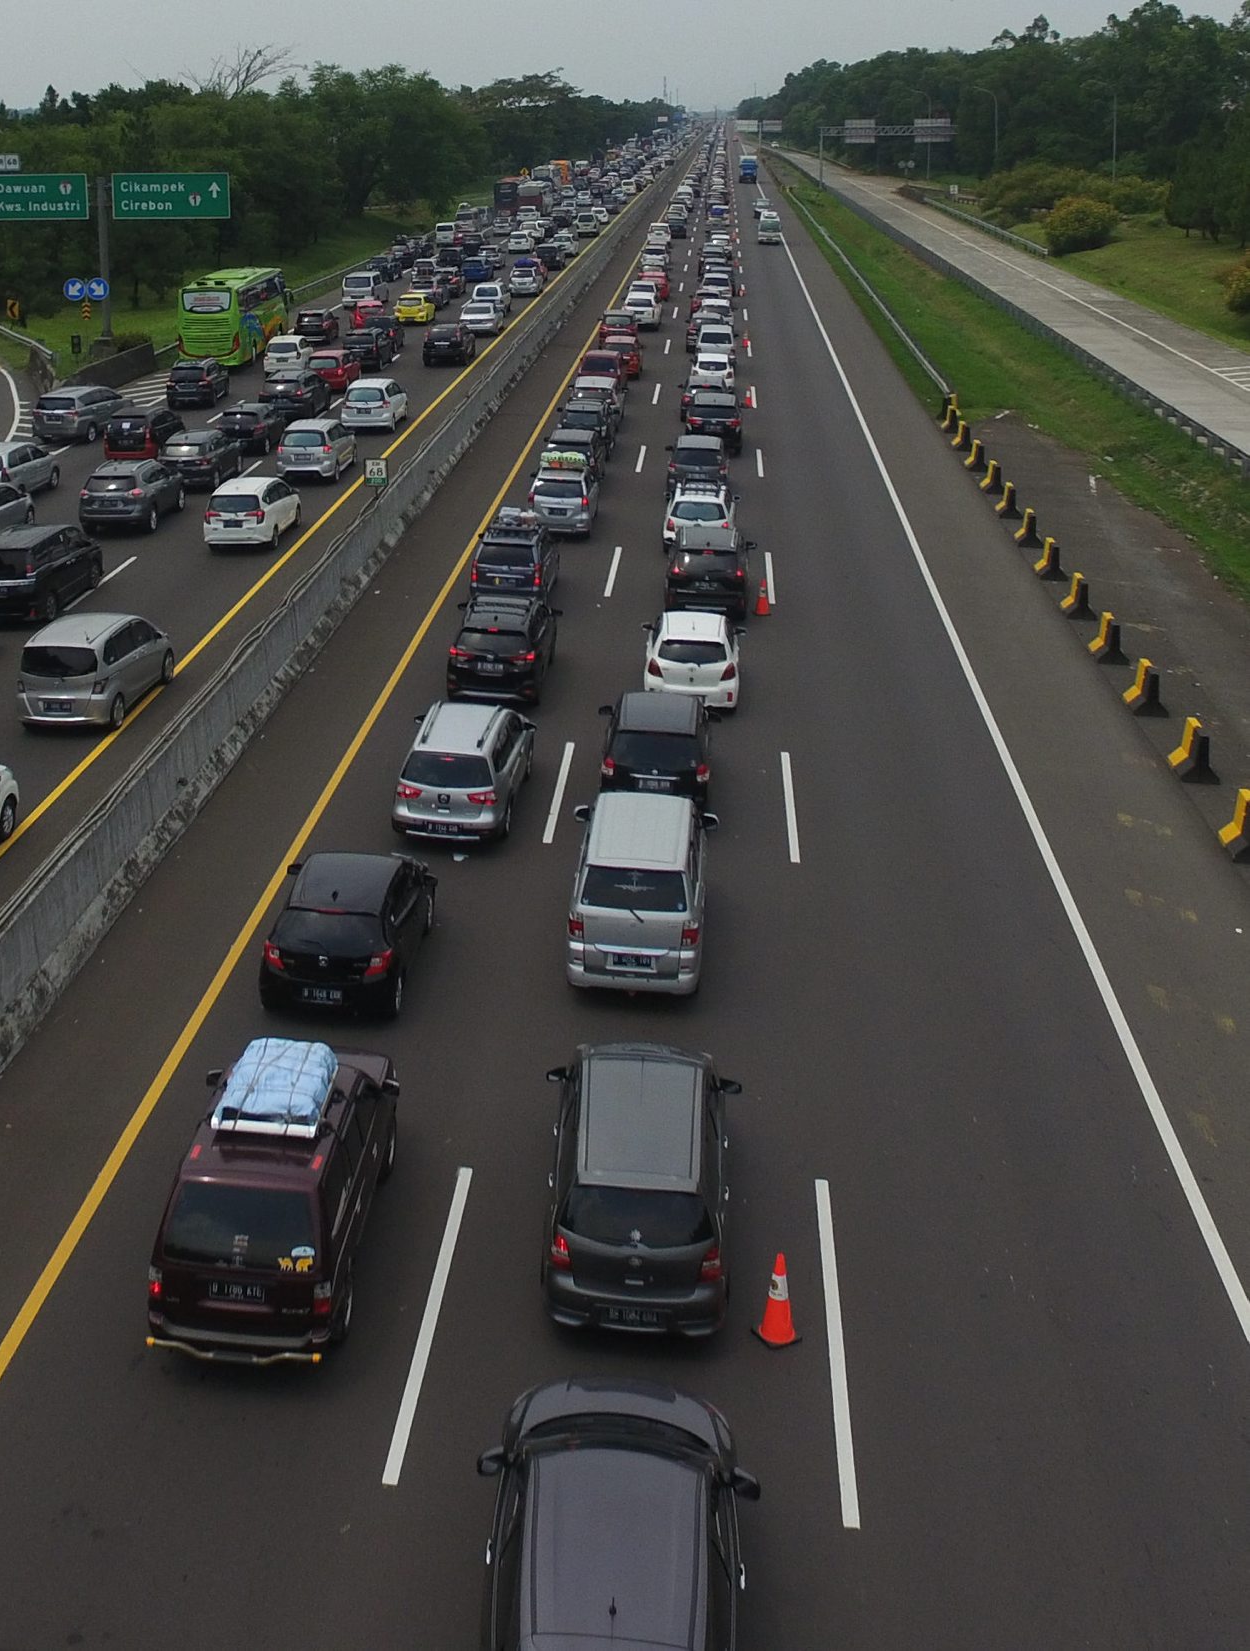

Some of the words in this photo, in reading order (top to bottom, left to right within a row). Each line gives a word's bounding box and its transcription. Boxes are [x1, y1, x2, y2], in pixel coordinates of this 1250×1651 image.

[120, 181, 185, 194] Cikampek
[29, 200, 81, 211] Industri
[121, 200, 172, 211] Cirebon
[369, 467, 384, 477] 68
